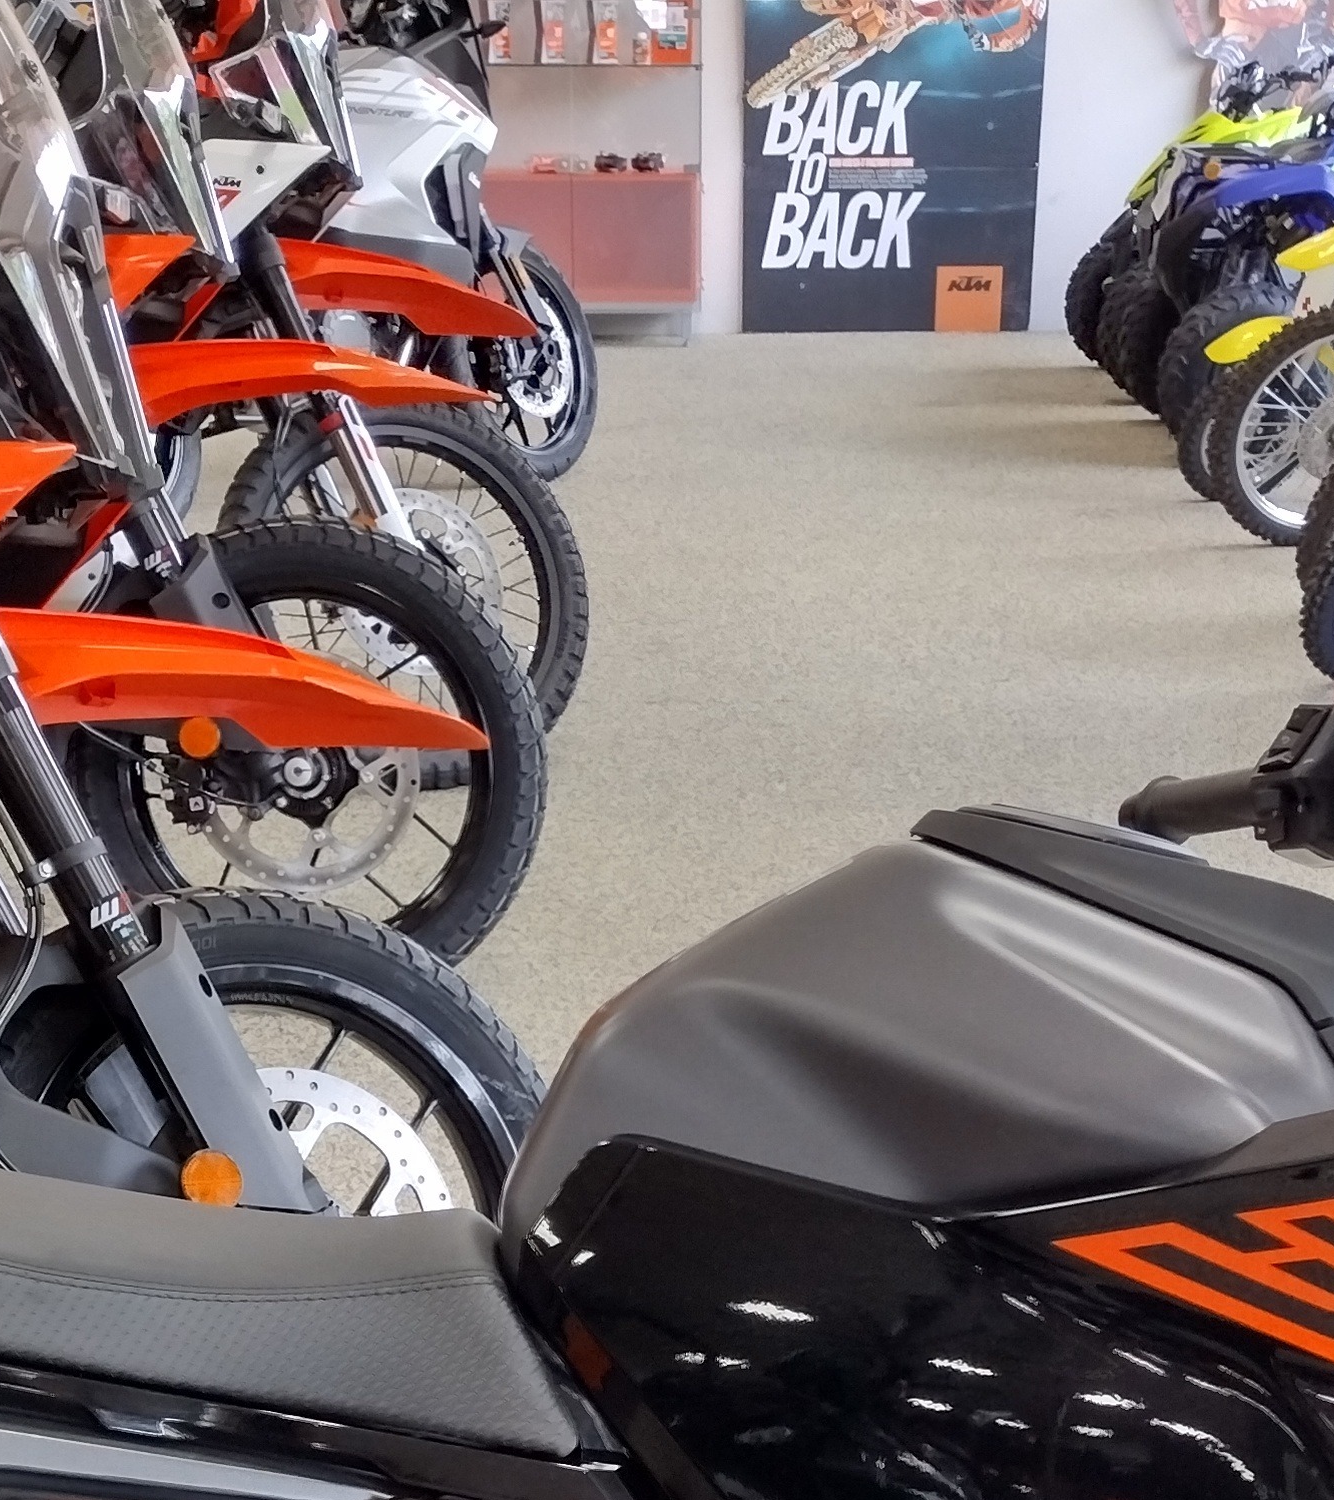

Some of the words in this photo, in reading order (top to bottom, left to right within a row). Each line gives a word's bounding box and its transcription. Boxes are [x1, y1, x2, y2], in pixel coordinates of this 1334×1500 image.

[762, 80, 922, 155] BACK
[787, 152, 827, 196] TO
[761, 191, 926, 269] BACK
[947, 275, 992, 292] KTM
